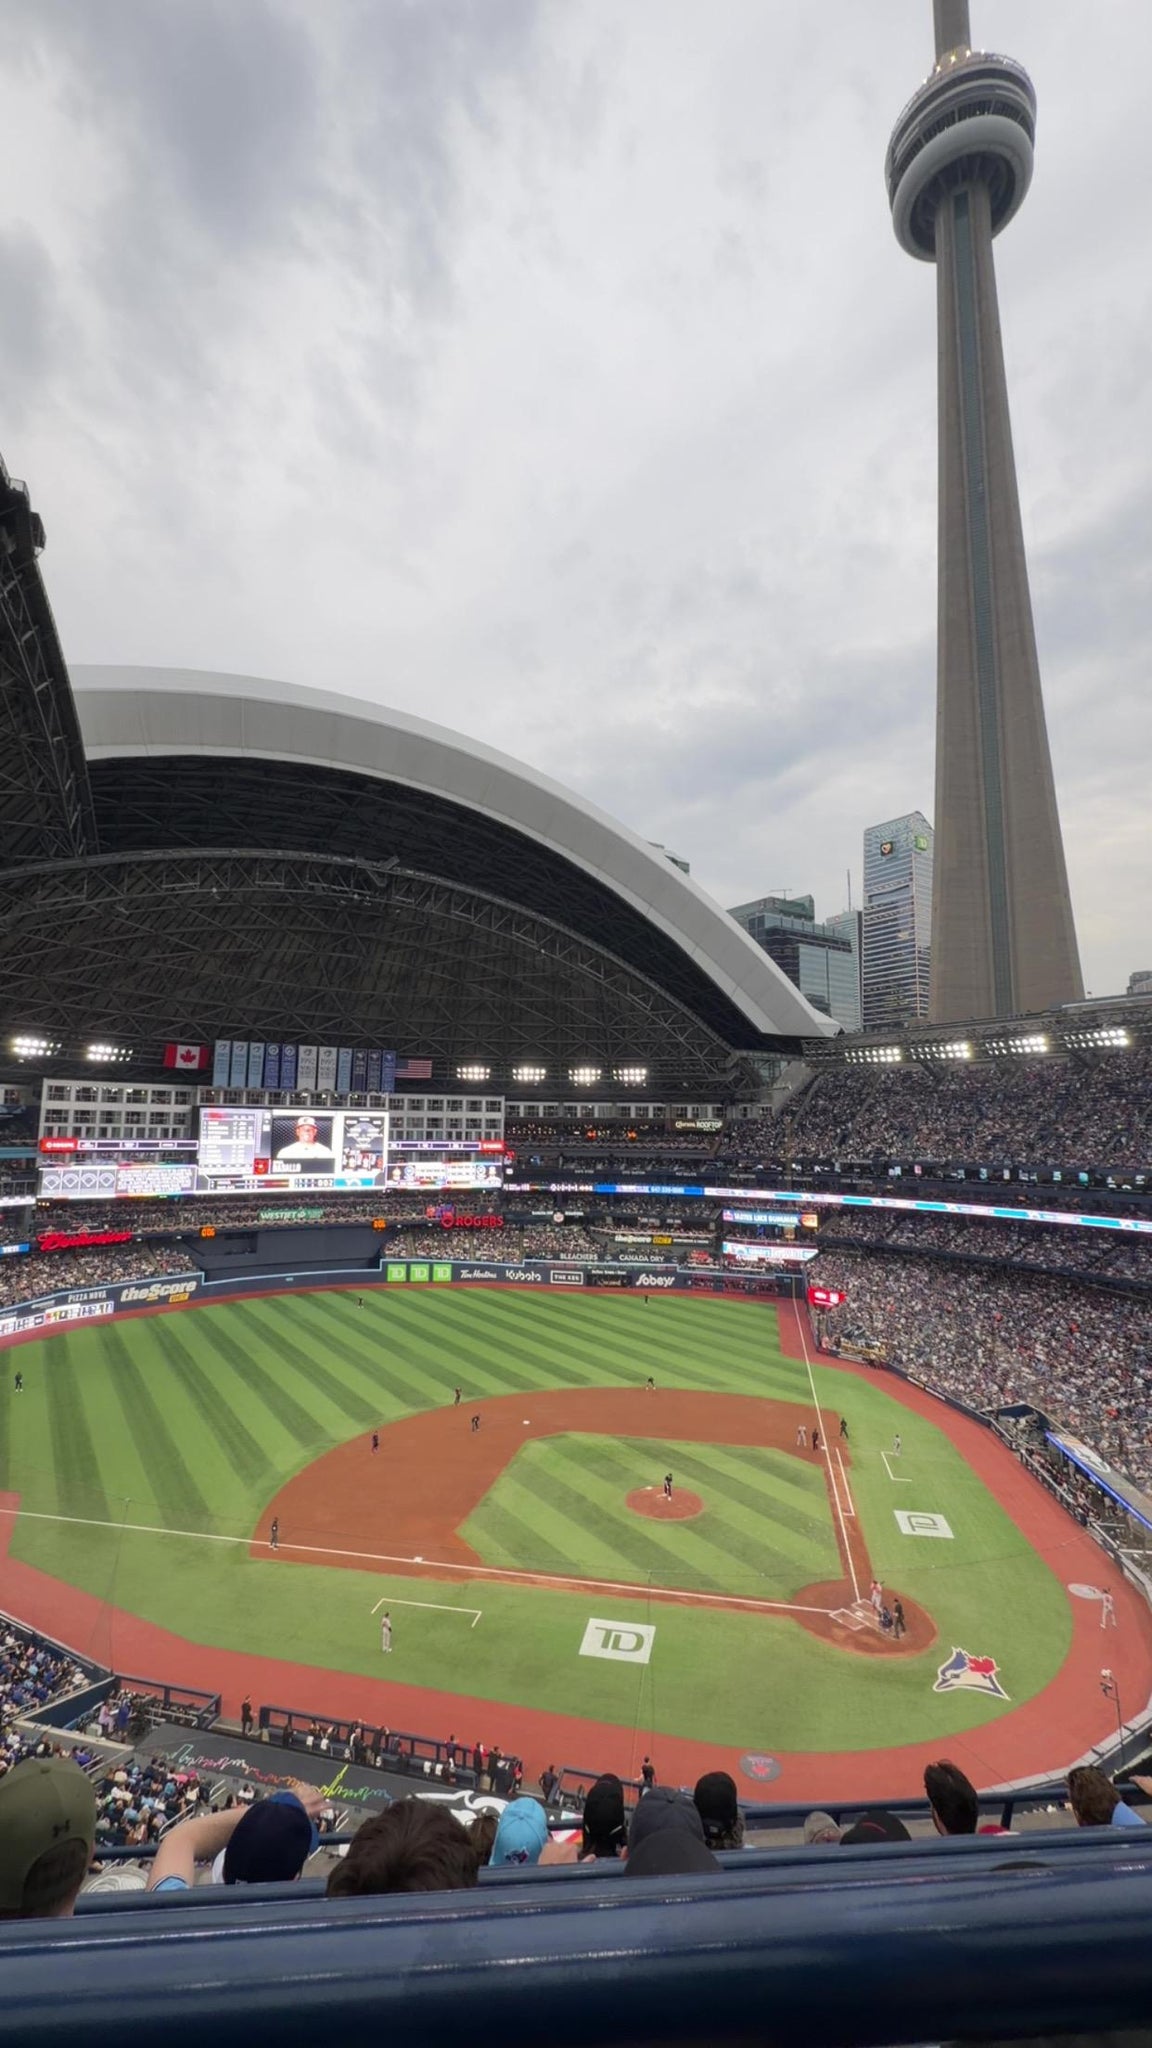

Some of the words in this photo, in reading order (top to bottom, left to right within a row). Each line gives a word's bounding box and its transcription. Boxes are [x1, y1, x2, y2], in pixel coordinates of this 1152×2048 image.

[260, 1211, 297, 1220] WESTJET
[455, 1215, 504, 1227] ROGERS
[560, 1252, 598, 1261] BLEACHERS
[619, 1254, 649, 1262] CANADA
[650, 1255, 665, 1263] DRY
[391, 1268, 404, 1279] TD
[414, 1268, 427, 1279] TD
[437, 1268, 450, 1279] TD
[460, 1269, 473, 1279] Tim
[473, 1269, 498, 1279] Hortons
[505, 1269, 542, 1282] Kubota
[635, 1273, 675, 1288] Sobeys
[67, 1293, 88, 1303] PIZZA
[88, 1290, 107, 1300] NOVA
[120, 1280, 197, 1302] theScore
[908, 1514, 940, 1533] TD
[594, 1626, 645, 1654] TD
